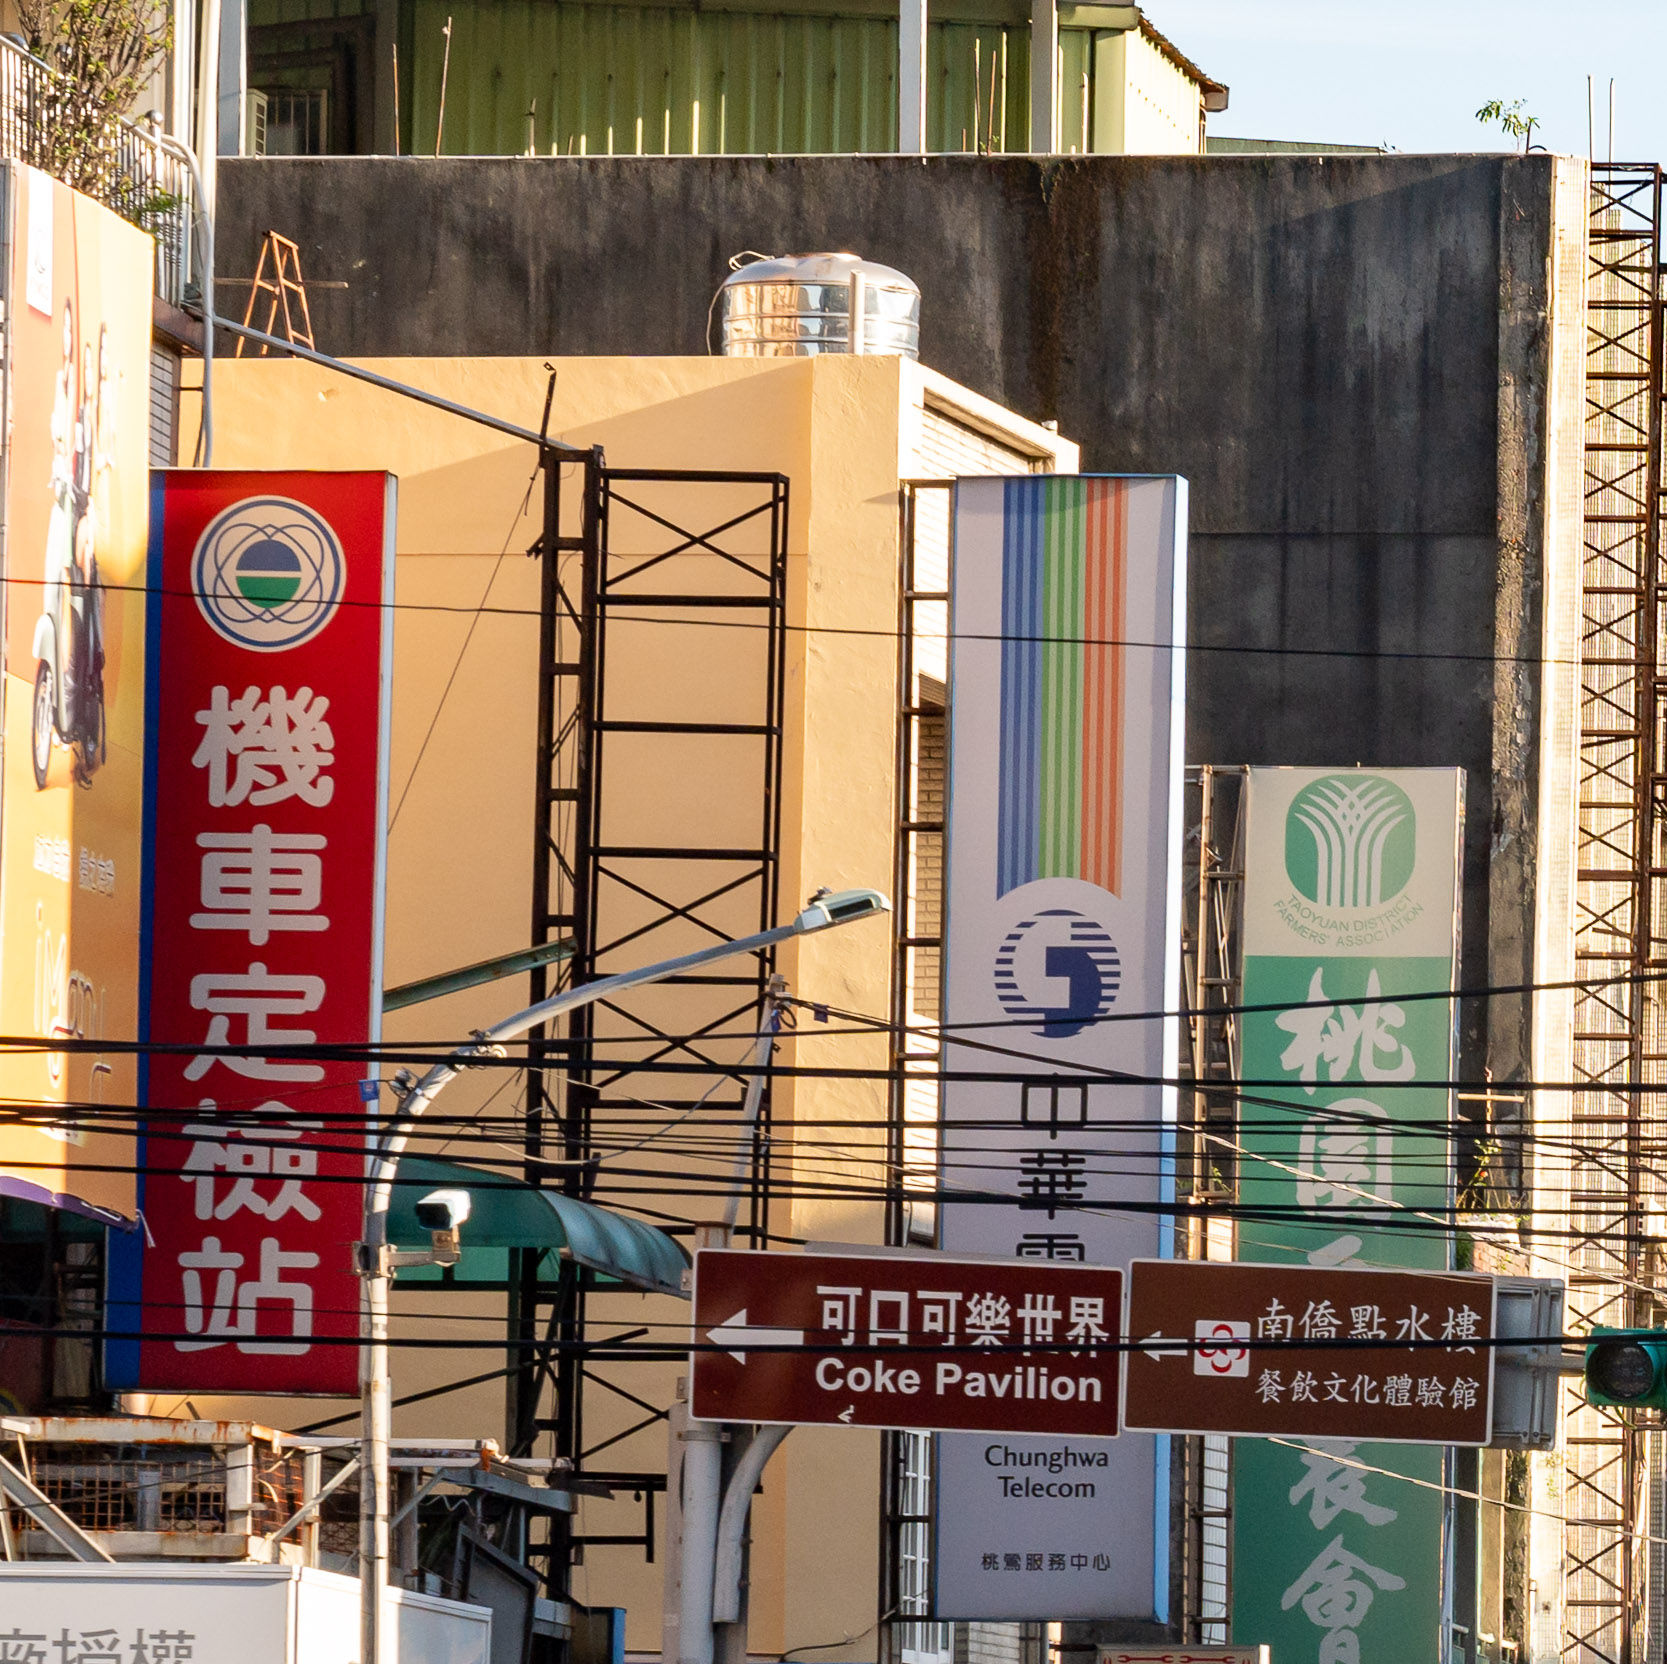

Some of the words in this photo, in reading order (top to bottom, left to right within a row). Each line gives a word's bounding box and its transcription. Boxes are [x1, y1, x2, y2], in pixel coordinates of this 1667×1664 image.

[1287, 894, 1351, 934] TAOYUAN
[1352, 894, 1413, 933] DISTRICT
[1335, 901, 1425, 949] ASSOCIATION
[176, 684, 336, 1356] 機車定檢站
[815, 1284, 1110, 1360] 可口可樂世界
[1256, 1297, 1482, 1356] 南僑點水樓
[815, 1356, 921, 1396] Coke
[936, 1363, 1103, 1403] Pavilion
[1255, 1368, 1481, 1412] 餐飲文化體驗館
[984, 1443, 1110, 1476] Chunghwa
[996, 1475, 1096, 1500] Telecom
[980, 1550, 1113, 1575] 桃鶯服務中心
